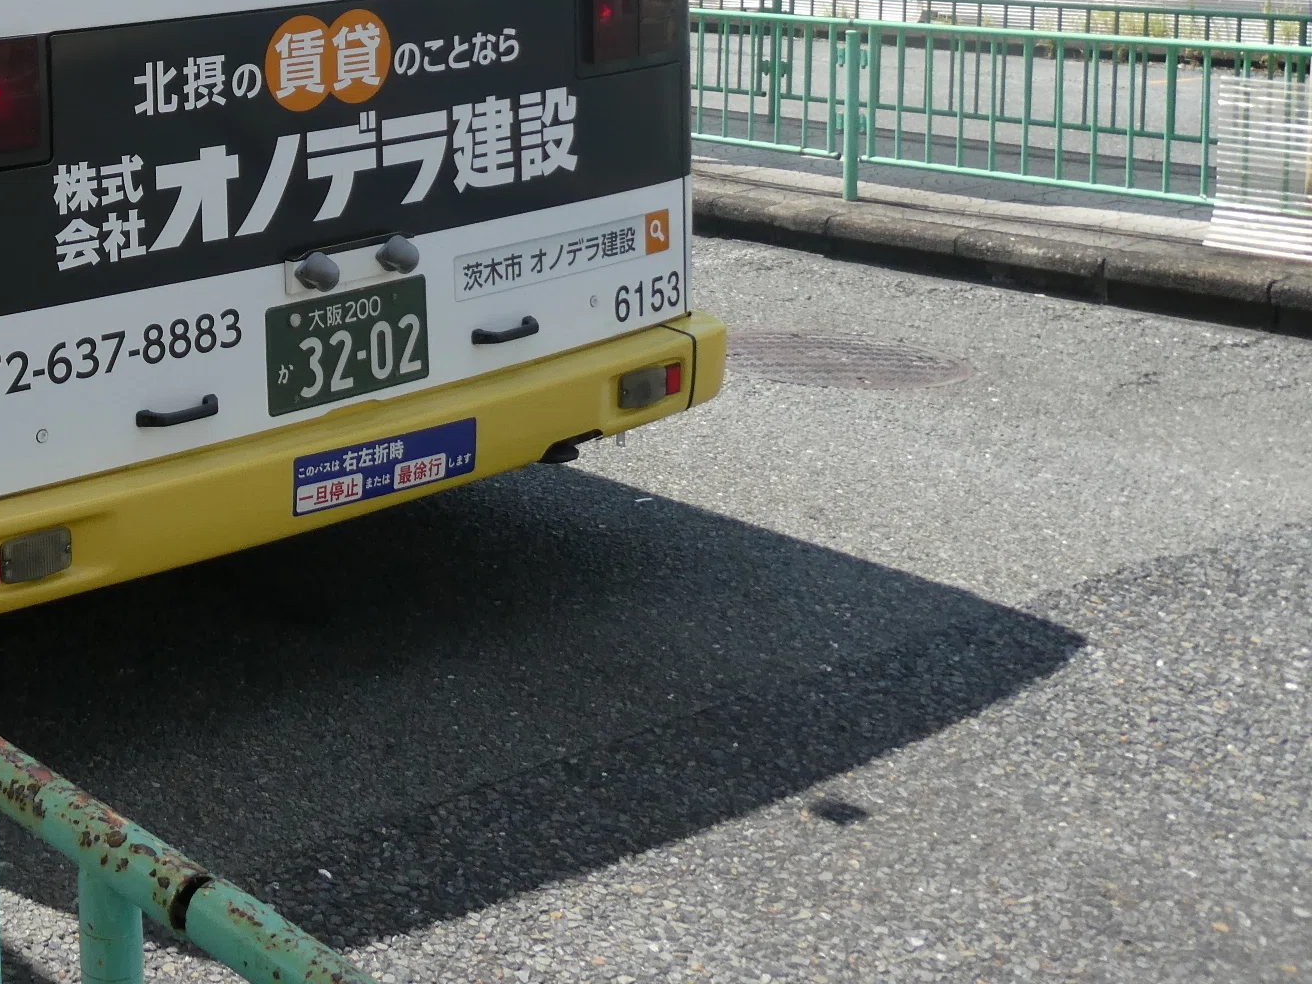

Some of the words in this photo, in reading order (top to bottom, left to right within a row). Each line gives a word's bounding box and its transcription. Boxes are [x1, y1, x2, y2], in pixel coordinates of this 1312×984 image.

[133, 21, 520, 117] 北摂の賃貸のことなら
[53, 154, 144, 215] 株式
[148, 86, 578, 253] オノデラ建設
[55, 209, 146, 271] 会社
[463, 253, 523, 291] 茨木市
[531, 227, 636, 273] オノデラ建設
[614, 270, 681, 323] 6153
[278, 364, 294, 384] か
[298, 313, 422, 398] 32-02
[298, 477, 360, 506] 一旦停止
[365, 474, 390, 489] または
[397, 457, 442, 486] 最徐行
[448, 452, 472, 469] します
